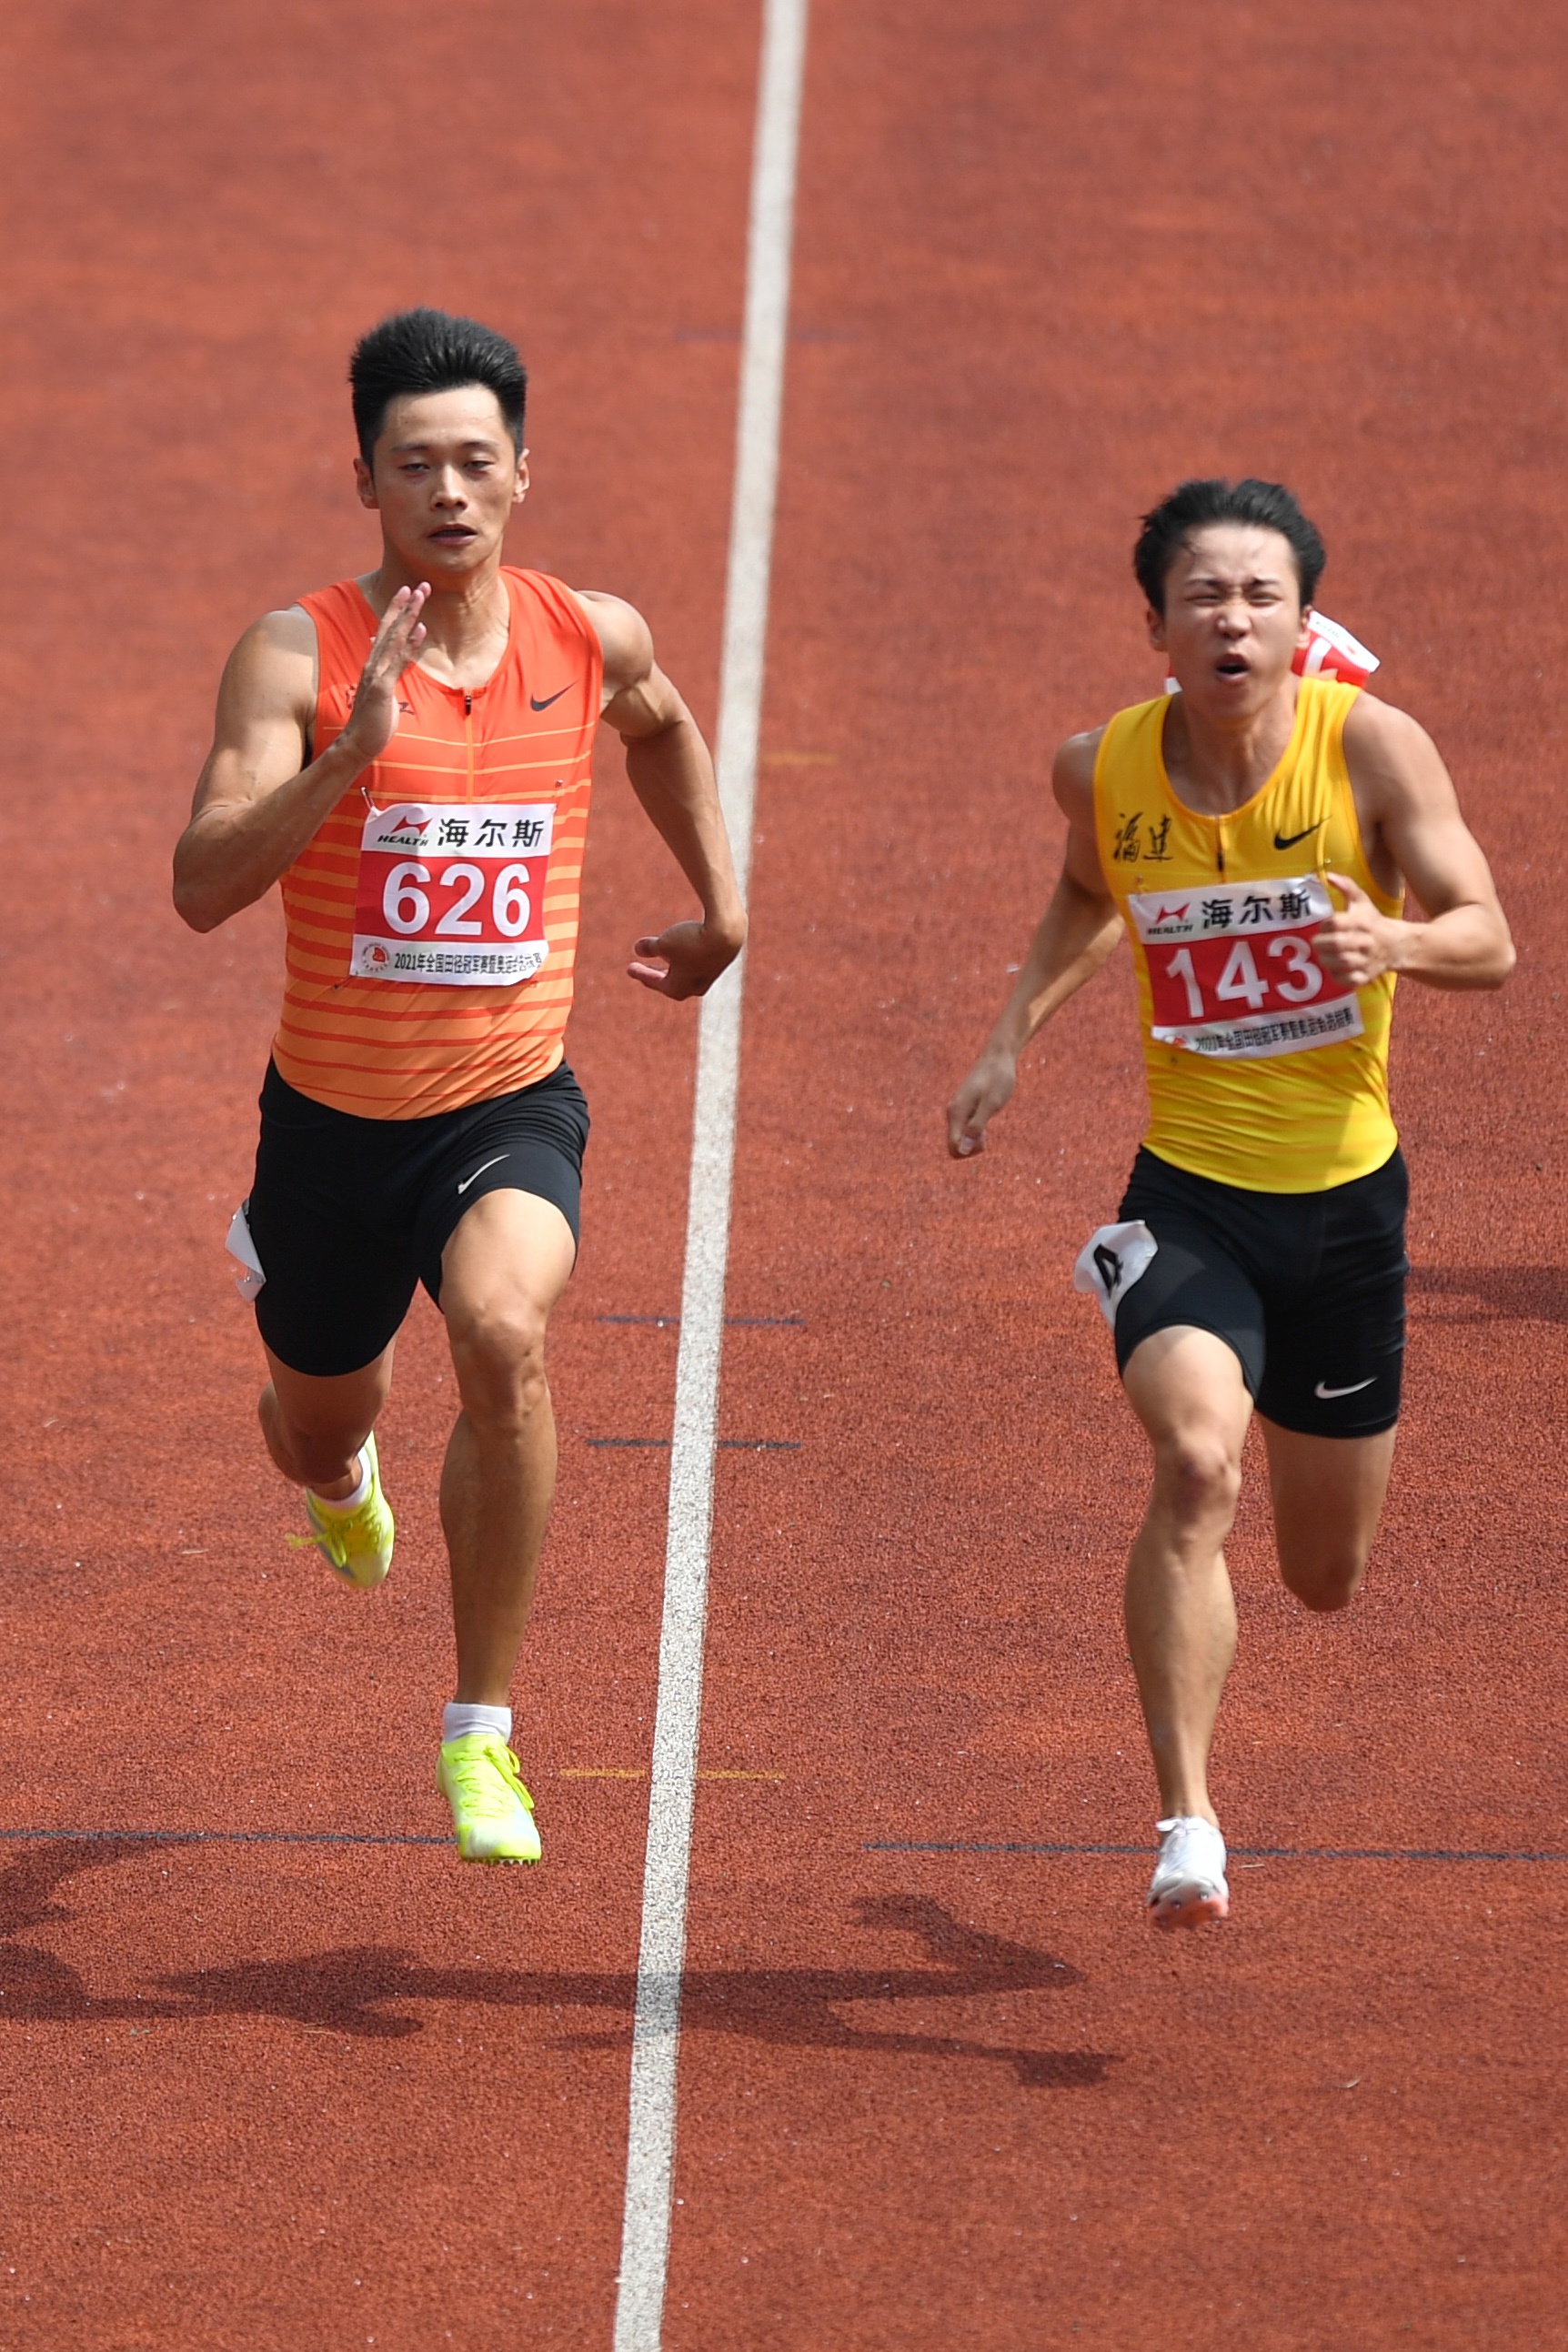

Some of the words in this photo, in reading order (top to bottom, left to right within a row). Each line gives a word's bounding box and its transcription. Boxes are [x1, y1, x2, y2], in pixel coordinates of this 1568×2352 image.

[377, 835, 428, 847] HEALTH
[437, 818, 545, 848] 海尔斯
[382, 860, 531, 937] 626
[1147, 924, 1193, 935] HEALTH
[1201, 889, 1312, 930] 海尔斯
[1165, 935, 1323, 1020] 143
